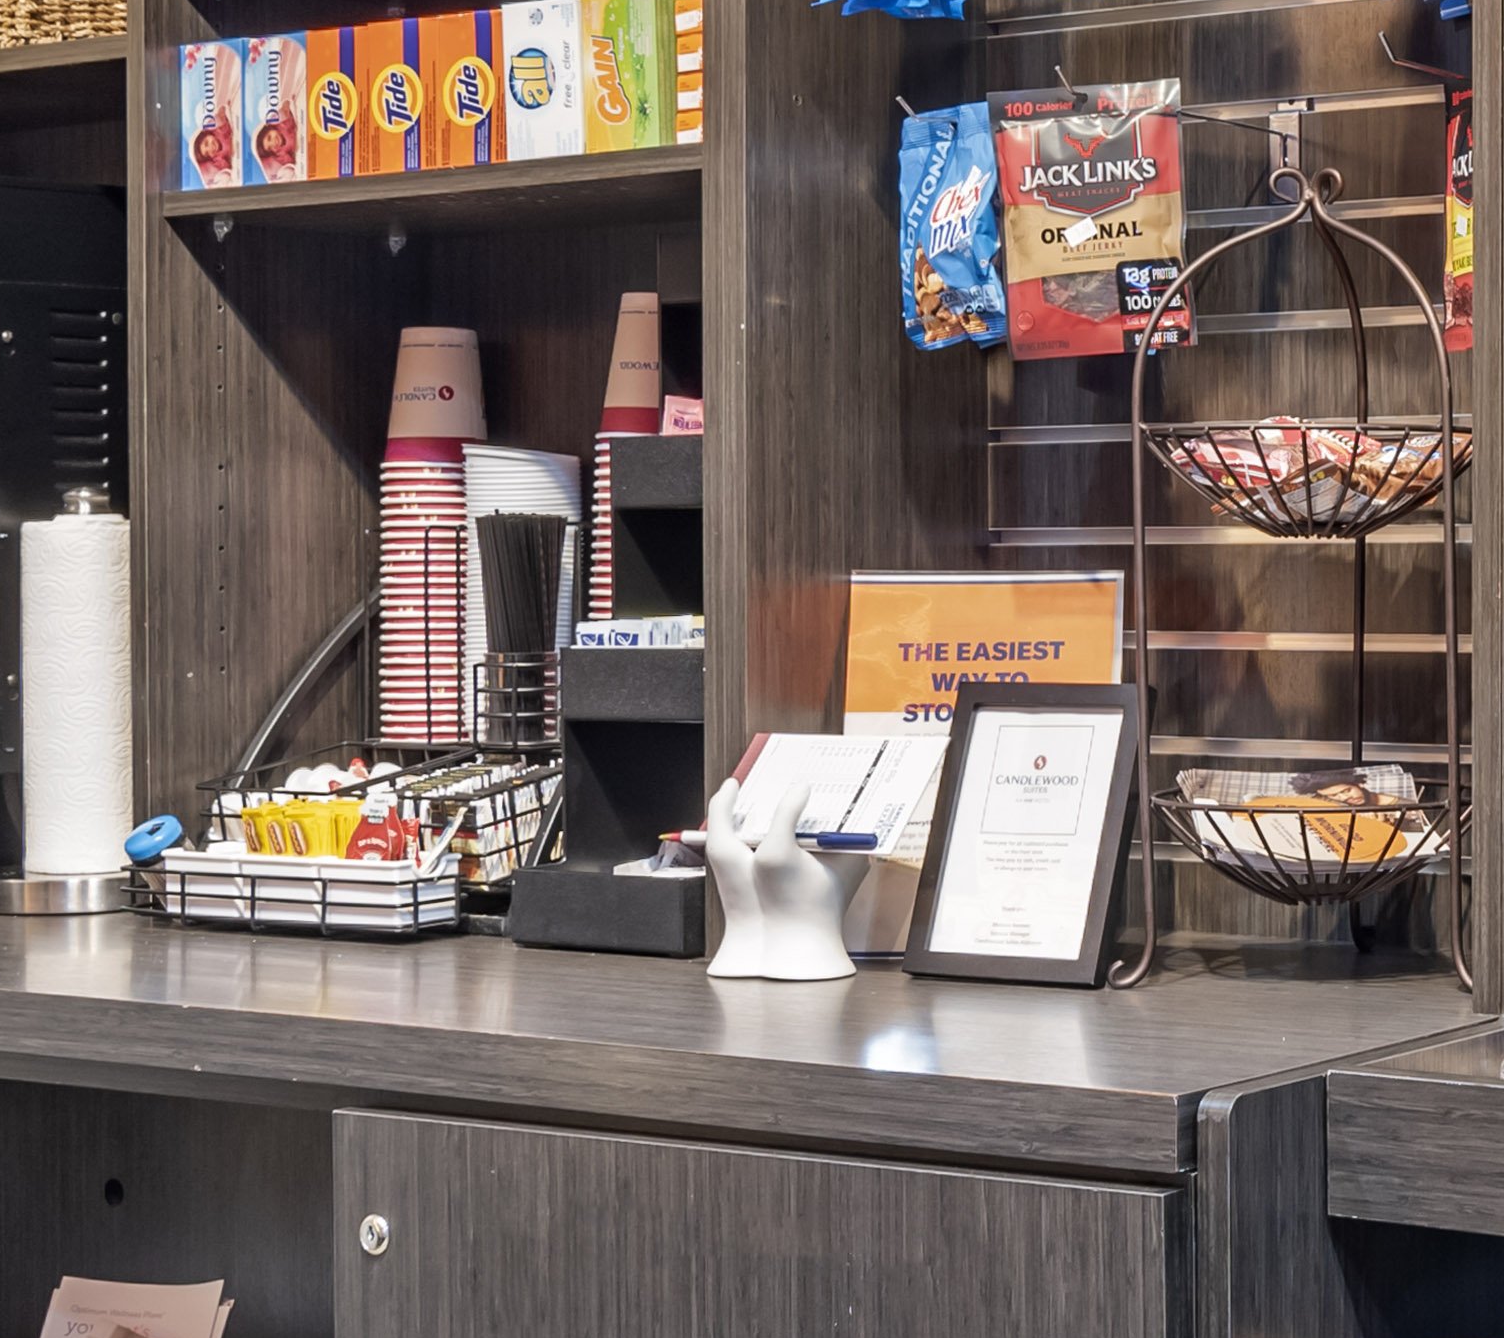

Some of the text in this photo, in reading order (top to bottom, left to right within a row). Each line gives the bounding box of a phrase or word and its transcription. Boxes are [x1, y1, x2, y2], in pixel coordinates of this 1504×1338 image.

[203, 57, 216, 129] Downy
[266, 50, 282, 124] Downy
[384, 72, 413, 125] Tide
[458, 65, 483, 120] Tide
[511, 56, 550, 105] all
[564, 84, 572, 109] free
[592, 37, 631, 124] GAIN
[322, 79, 348, 133] Tide
[1004, 101, 1033, 117] 100
[1020, 158, 1157, 192] JACK LINK'S
[932, 183, 981, 224] Chex
[1041, 221, 1143, 245] ORNAL
[1125, 295, 1152, 311] 100
[898, 641, 1064, 662] THE EASIEST
[903, 703, 953, 722] STO
[995, 775, 1079, 786] CANDLEWOOD
